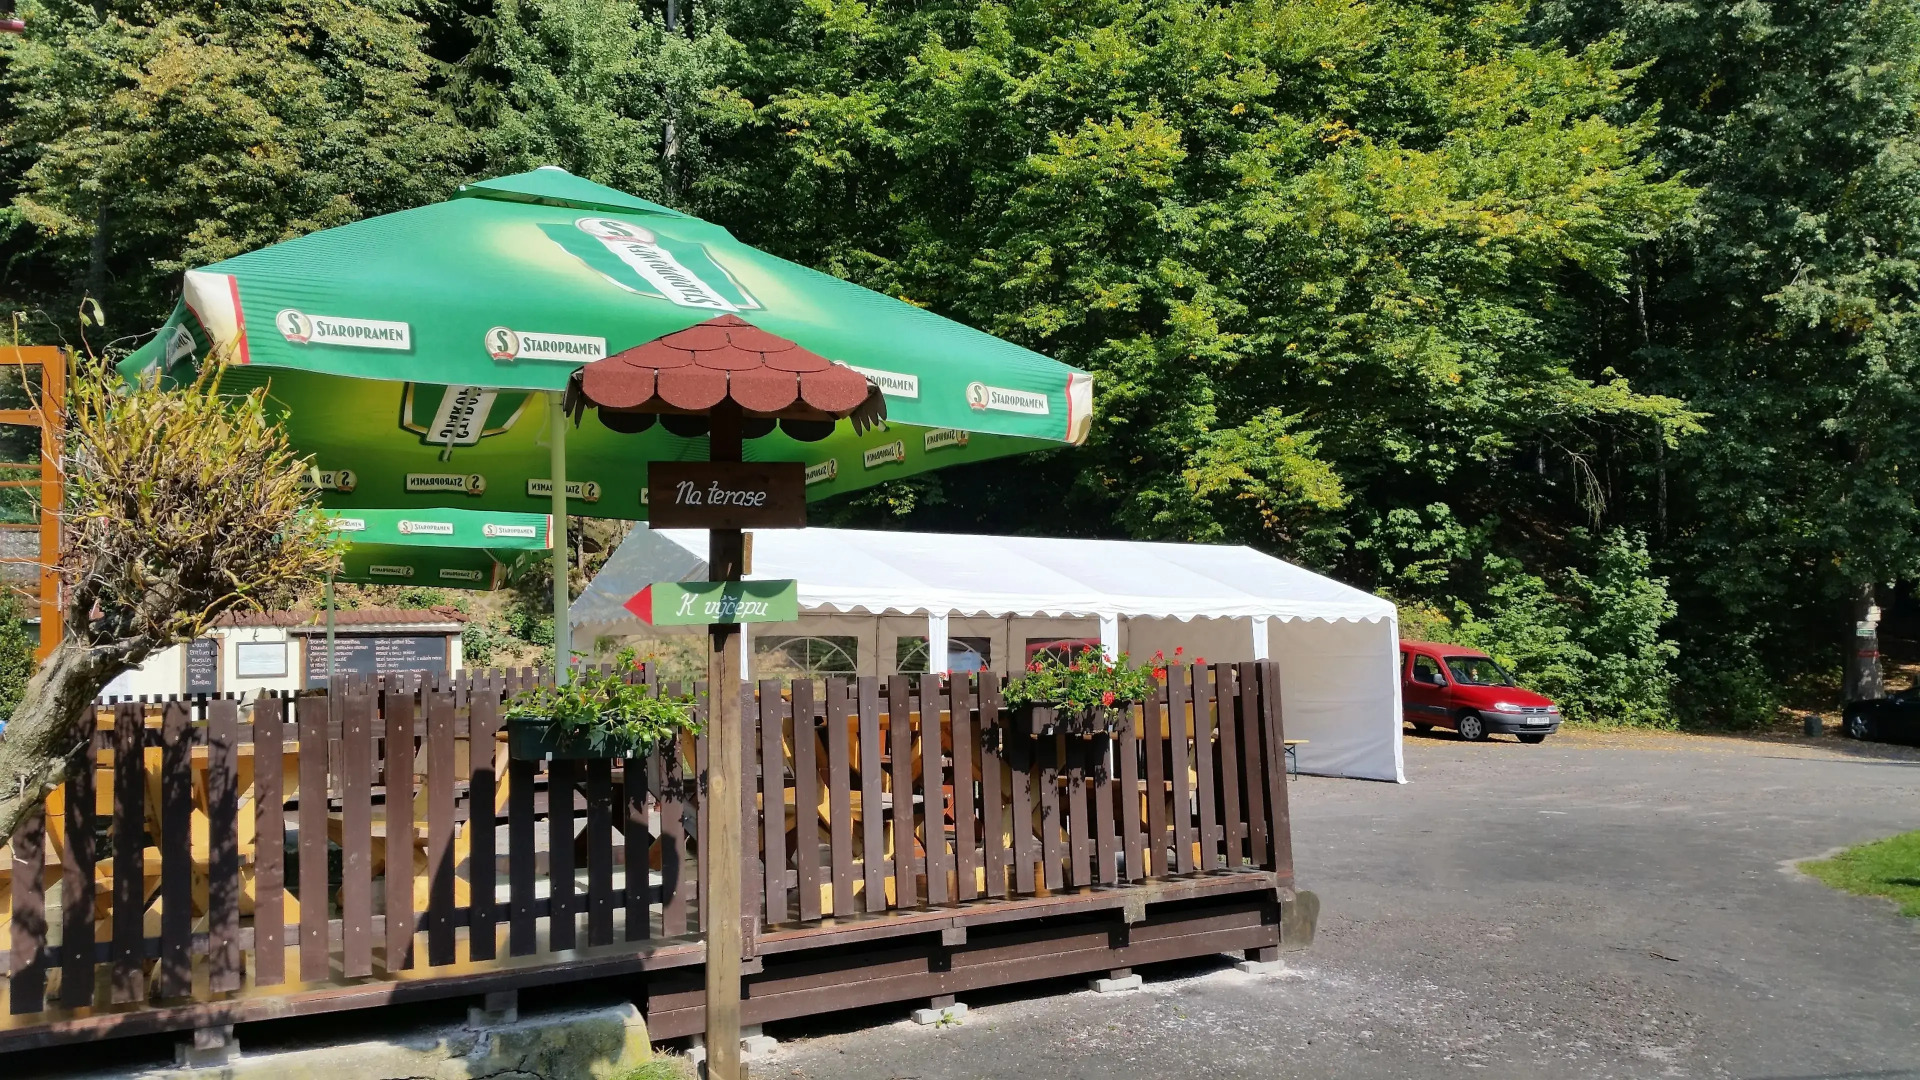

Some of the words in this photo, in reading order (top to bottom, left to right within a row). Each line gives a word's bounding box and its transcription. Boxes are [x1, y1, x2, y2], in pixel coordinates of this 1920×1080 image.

[624, 243, 722, 307] STAROPRAMEN
[288, 313, 301, 334] S
[317, 321, 403, 340] STAROPRAMEN
[497, 330, 508, 352] S
[524, 337, 600, 355] STAROPRAMEN
[974, 385, 982, 402] S
[992, 392, 1044, 408] STAROPRAMEN
[675, 480, 702, 504] Na
[707, 480, 766, 506] terase
[676, 592, 698, 616] K
[704, 594, 768, 619] výčepu
